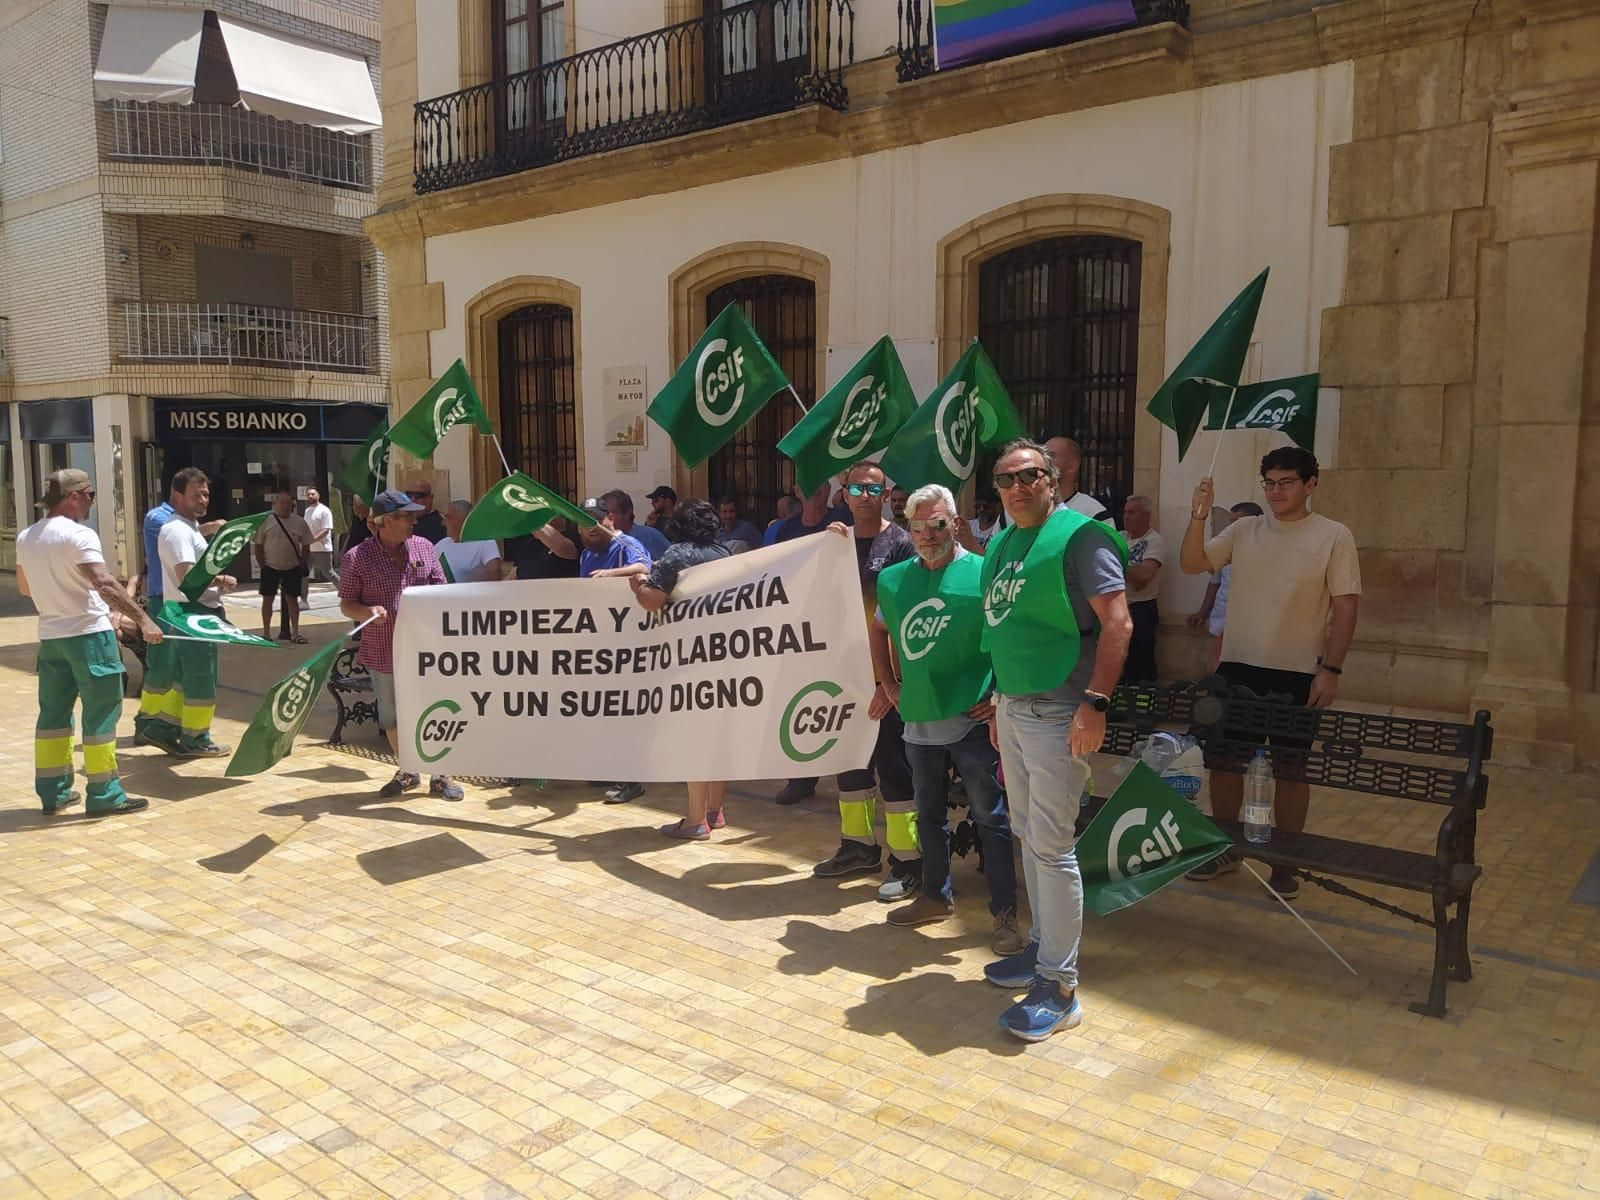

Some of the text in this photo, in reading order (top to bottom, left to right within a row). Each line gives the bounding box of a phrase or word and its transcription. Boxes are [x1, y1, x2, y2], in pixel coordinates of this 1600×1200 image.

[706, 346, 744, 403] CSIF
[618, 392, 643, 400] MAYOR
[841, 381, 886, 437] CSIF
[170, 411, 307, 430] MISS BIANKO
[951, 386, 979, 455] CSIF
[1251, 405, 1301, 424] CSIF
[442, 573, 789, 636] LIMPIEZA Y JARDINERÍA
[992, 579, 1026, 603] CSIF
[907, 615, 952, 639] CSIF
[418, 621, 827, 676] POR UN RESPETO LABORAL
[282, 667, 312, 719] CSIF
[471, 676, 764, 717] Y UN SUELDO DIGNO
[422, 719, 468, 742] CSIF
[793, 703, 856, 735] CSIF
